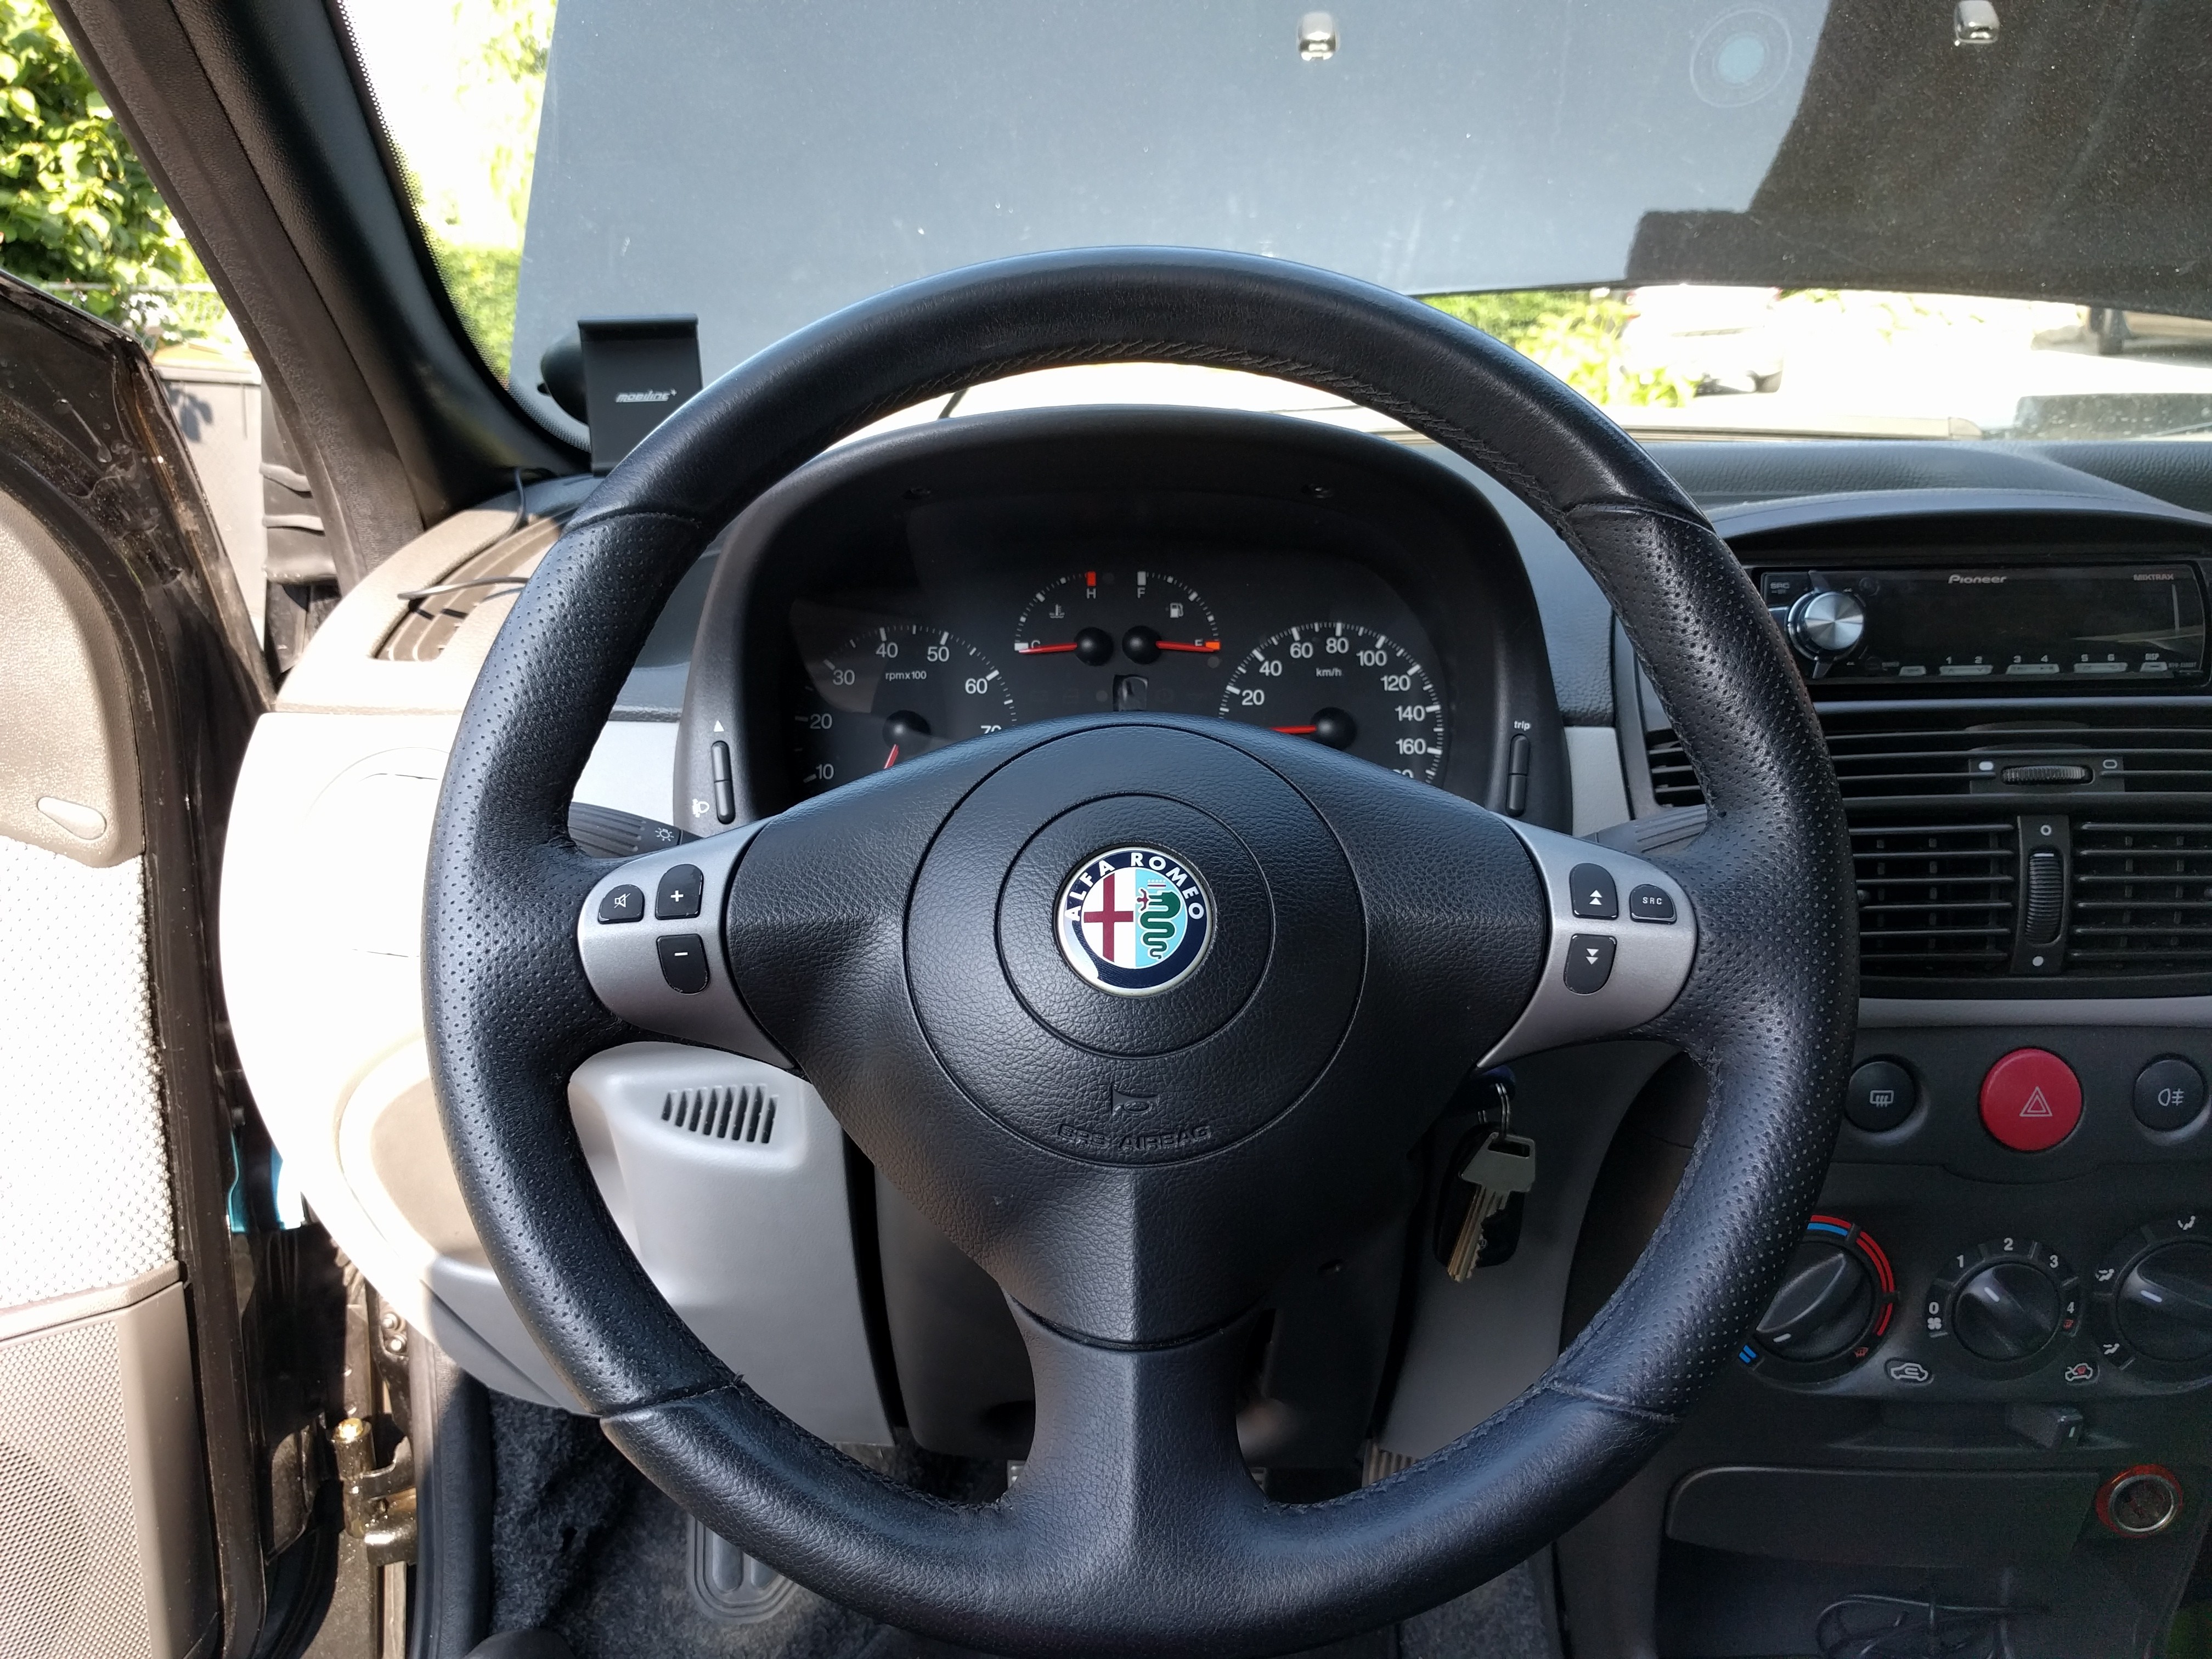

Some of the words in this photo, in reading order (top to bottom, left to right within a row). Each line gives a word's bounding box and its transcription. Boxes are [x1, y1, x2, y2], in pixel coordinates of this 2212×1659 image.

[1948, 574, 2007, 584] Pioneer
[1086, 588, 1096, 599] H
[1137, 588, 1146, 599] F
[876, 642, 898, 658] 40
[1290, 643, 1313, 658] 60
[1326, 637, 1349, 653] 80
[927, 646, 950, 662] 50
[1356, 651, 1387, 667] 100
[1259, 661, 1282, 676] 40
[1316, 668, 1342, 678] km/h
[833, 670, 855, 685] 30
[1381, 675, 1411, 692] 120
[965, 679, 988, 694] 60
[1242, 691, 1265, 706] 20
[1395, 706, 1425, 722] 140
[810, 714, 832, 730] 20
[1514, 720, 1531, 731] trip
[1396, 739, 1426, 754] 160
[816, 764, 834, 780] 10
[1065, 860, 1115, 922] ALFA
[1131, 852, 1204, 920] ROMEO
[1119, 1125, 1212, 1152] AIRBAG
[2004, 1238, 2013, 1252] 2
[1957, 1255, 1964, 1268] 1
[2050, 1255, 2059, 1268] 3
[1928, 1302, 1939, 1315] 0
[2067, 1302, 2075, 1314] 4
